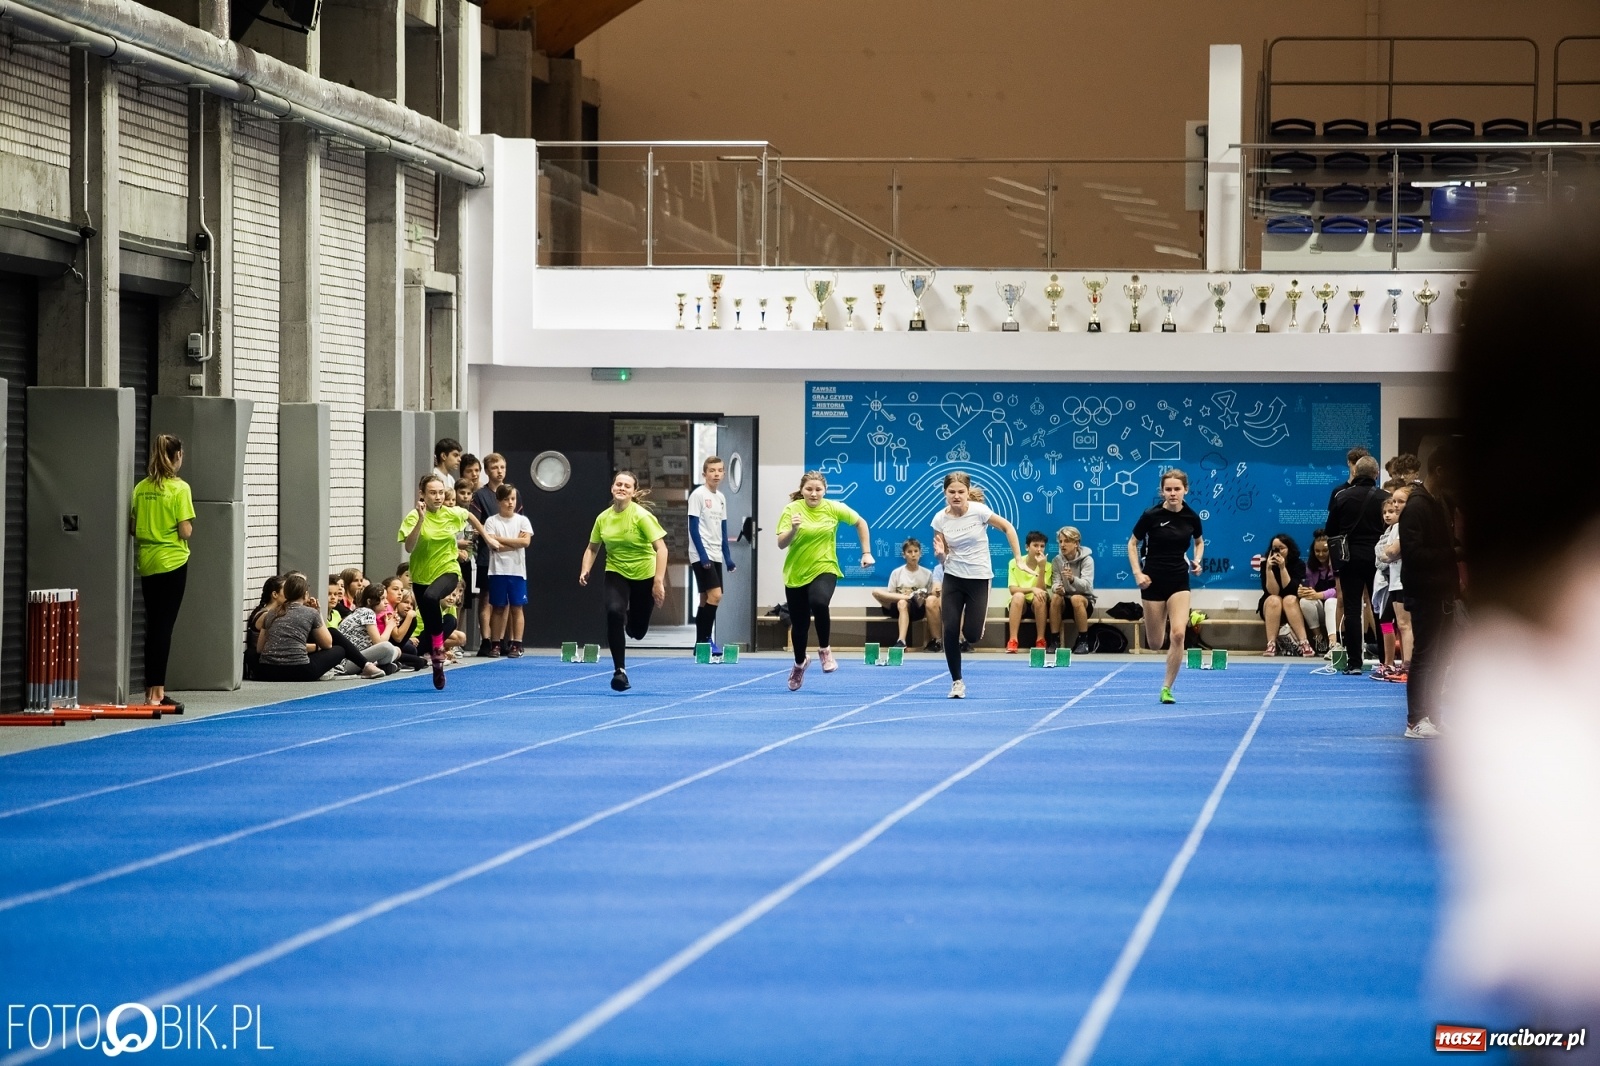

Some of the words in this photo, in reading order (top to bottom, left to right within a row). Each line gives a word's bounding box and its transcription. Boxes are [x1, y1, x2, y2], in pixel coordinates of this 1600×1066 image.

[1076, 436, 1094, 444] GO!
[1094, 492, 1098, 502] 1
[1203, 558, 1230, 566] FAIR
